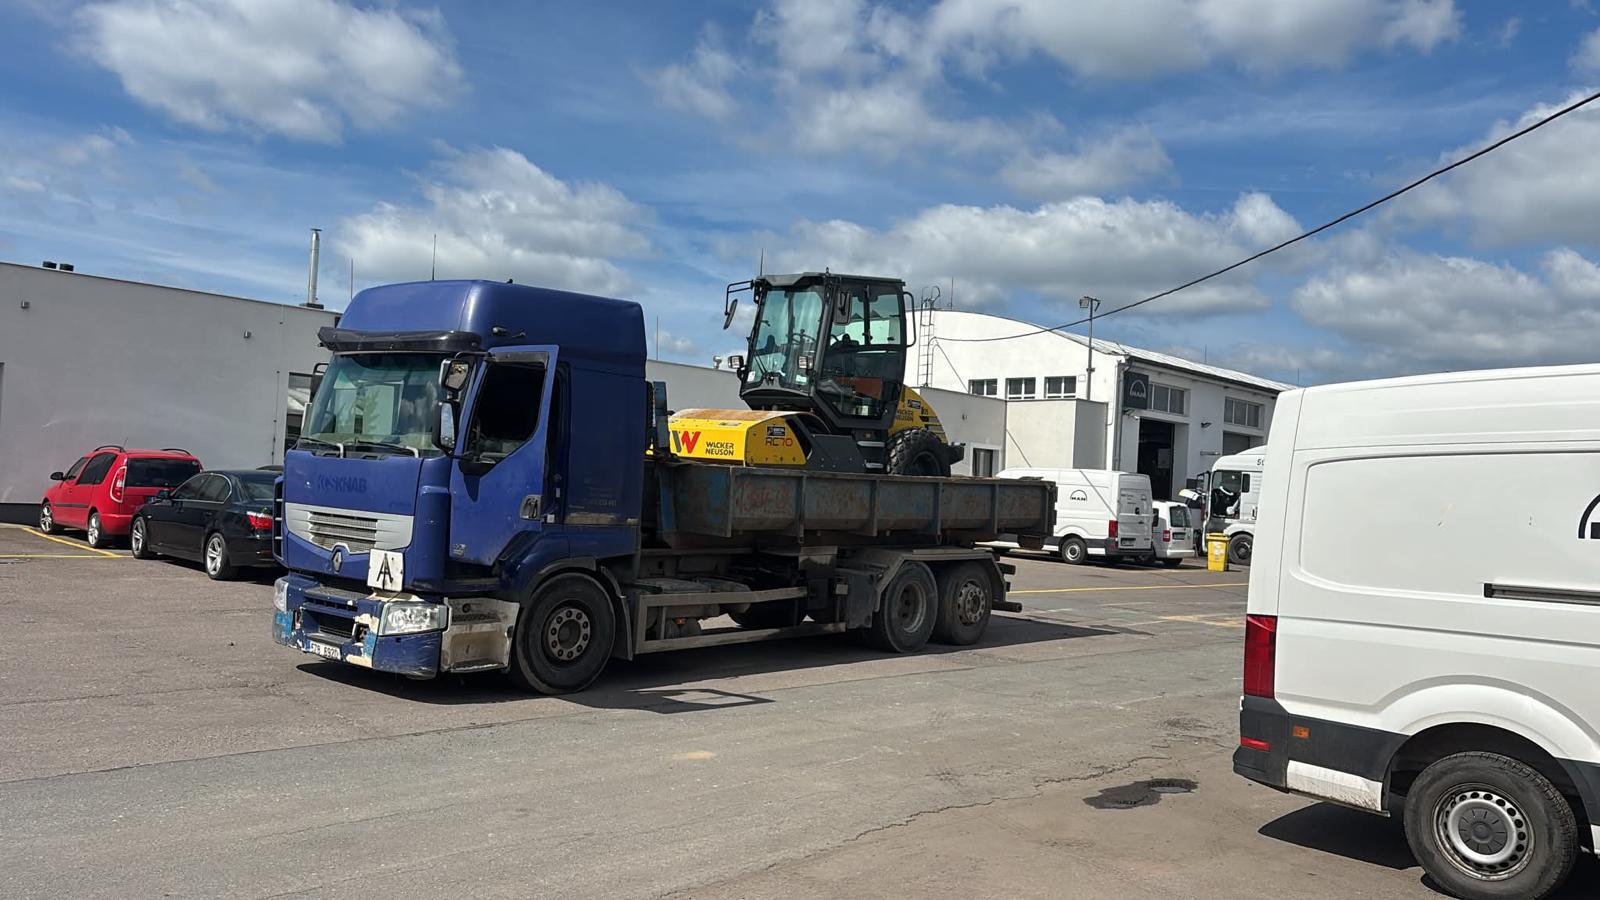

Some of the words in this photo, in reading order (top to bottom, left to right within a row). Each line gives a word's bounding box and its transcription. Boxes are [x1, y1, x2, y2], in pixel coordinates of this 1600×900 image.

[705, 441, 734, 449] WACKER
[765, 437, 793, 447] RC70
[705, 448, 734, 456] NEUSON
